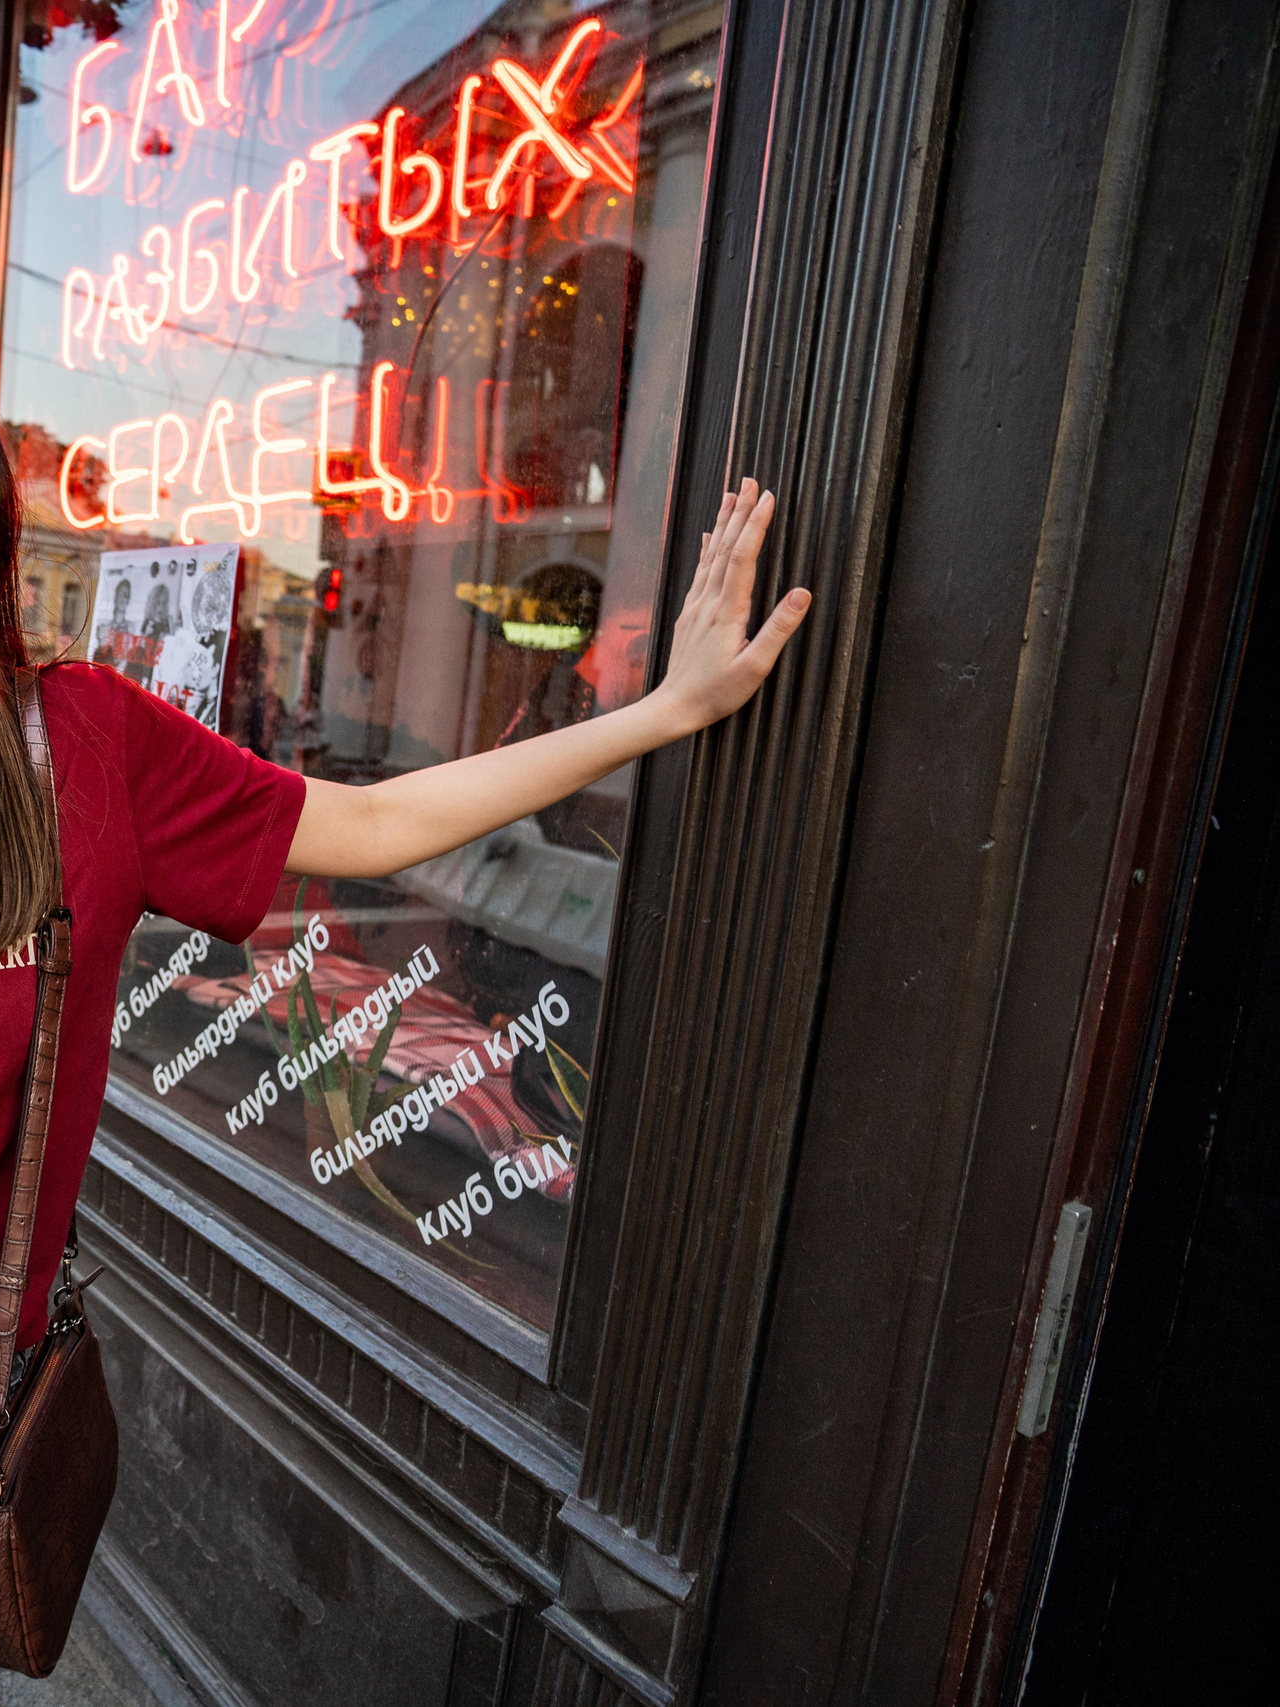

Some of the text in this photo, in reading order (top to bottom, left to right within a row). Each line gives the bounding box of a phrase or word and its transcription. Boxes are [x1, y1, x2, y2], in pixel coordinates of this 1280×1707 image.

[62, 18, 602, 370] РАЗБИТЫХ
[59, 361, 410, 547] СЕРДЕЦ
[110, 1000, 132, 1050] уб
[152, 913, 331, 1096] бильярдный клуб
[224, 943, 442, 1136] клуб бильярдный
[309, 980, 571, 1185] бильярдный клуб
[415, 1171, 494, 1246] клуб
